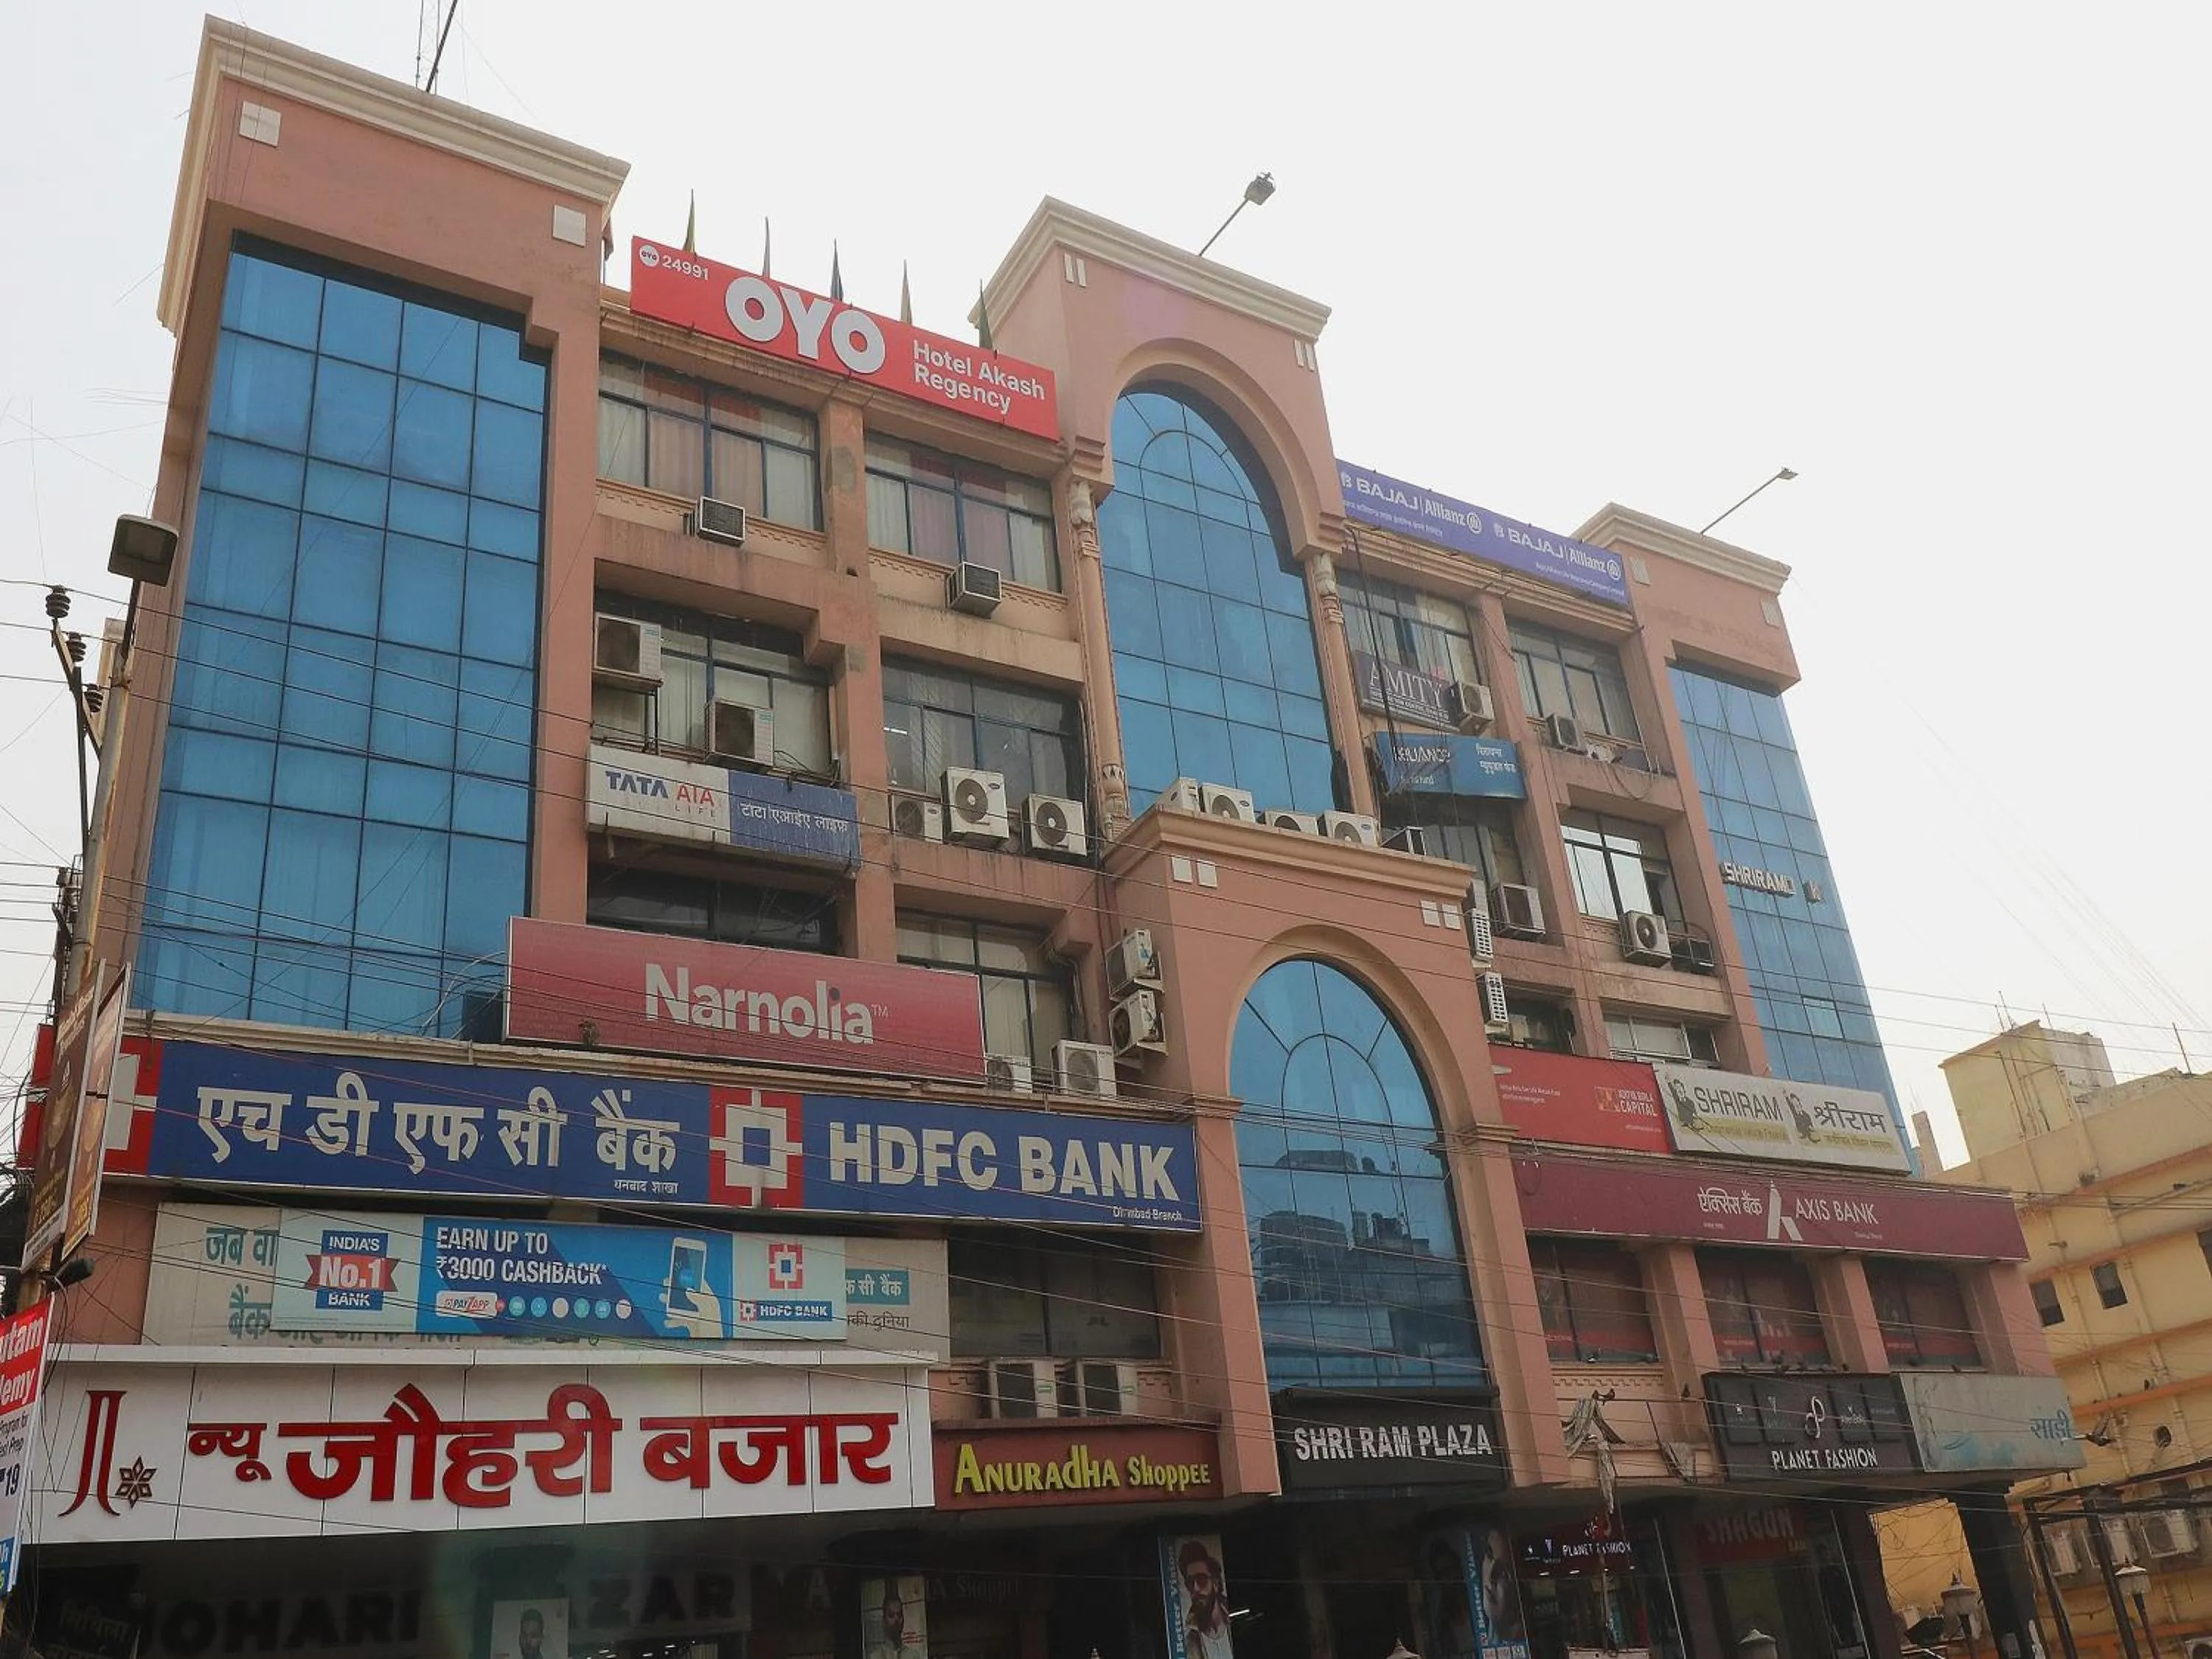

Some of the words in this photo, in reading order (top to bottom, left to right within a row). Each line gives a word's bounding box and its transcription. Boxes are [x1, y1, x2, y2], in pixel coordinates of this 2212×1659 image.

[662, 254, 709, 281] 24991
[725, 276, 886, 375] OYO
[913, 340, 973, 377] Hotel
[978, 361, 1045, 400] Akash
[914, 362, 1011, 414] Regency
[1356, 476, 1418, 511] BAJAJ
[1425, 498, 1466, 526] Allianz
[1508, 528, 1563, 559] BAJAJ
[1568, 547, 1607, 573] Allianz
[1370, 661, 1442, 709] AMITY
[605, 771, 669, 799] TATA
[676, 782, 714, 807] AIA
[740, 802, 767, 819] टाटा
[644, 963, 874, 1045] Narnolia
[1620, 1099, 1658, 1117] CAPITAL
[1694, 1086, 1783, 1121] SHRIRAM
[1814, 1101, 1887, 1134] श्रीराम
[197, 1086, 293, 1163] एच
[305, 1071, 379, 1157] डी
[394, 1102, 484, 1174] एफ
[497, 1086, 568, 1167] सी
[591, 1087, 680, 1173] बैंक
[829, 1121, 998, 1191] HDFC
[1018, 1135, 1181, 1202] BANK
[1795, 1197, 1830, 1222] AXIS
[1832, 1200, 1879, 1225] BANK
[329, 1236, 380, 1251] INDIA'S
[437, 1226, 489, 1252] EARN
[494, 1229, 519, 1253] UP
[524, 1232, 549, 1255] TO
[319, 1255, 383, 1288] No.1
[328, 1293, 371, 1307] BANK
[760, 1307, 793, 1317] HDFC
[795, 1306, 828, 1318] BANK
[187, 1422, 272, 1481] न्यू
[278, 1382, 622, 1508] जौहरी
[640, 1413, 899, 1490] बजार
[1294, 1427, 1355, 1461] SHRI
[1359, 1425, 1413, 1459] RAM
[1417, 1423, 1494, 1457] PLAZA
[1772, 1450, 1819, 1470] PLANET
[1825, 1447, 1878, 1469] FASHION
[1562, 1543, 1593, 1557] PLANET
